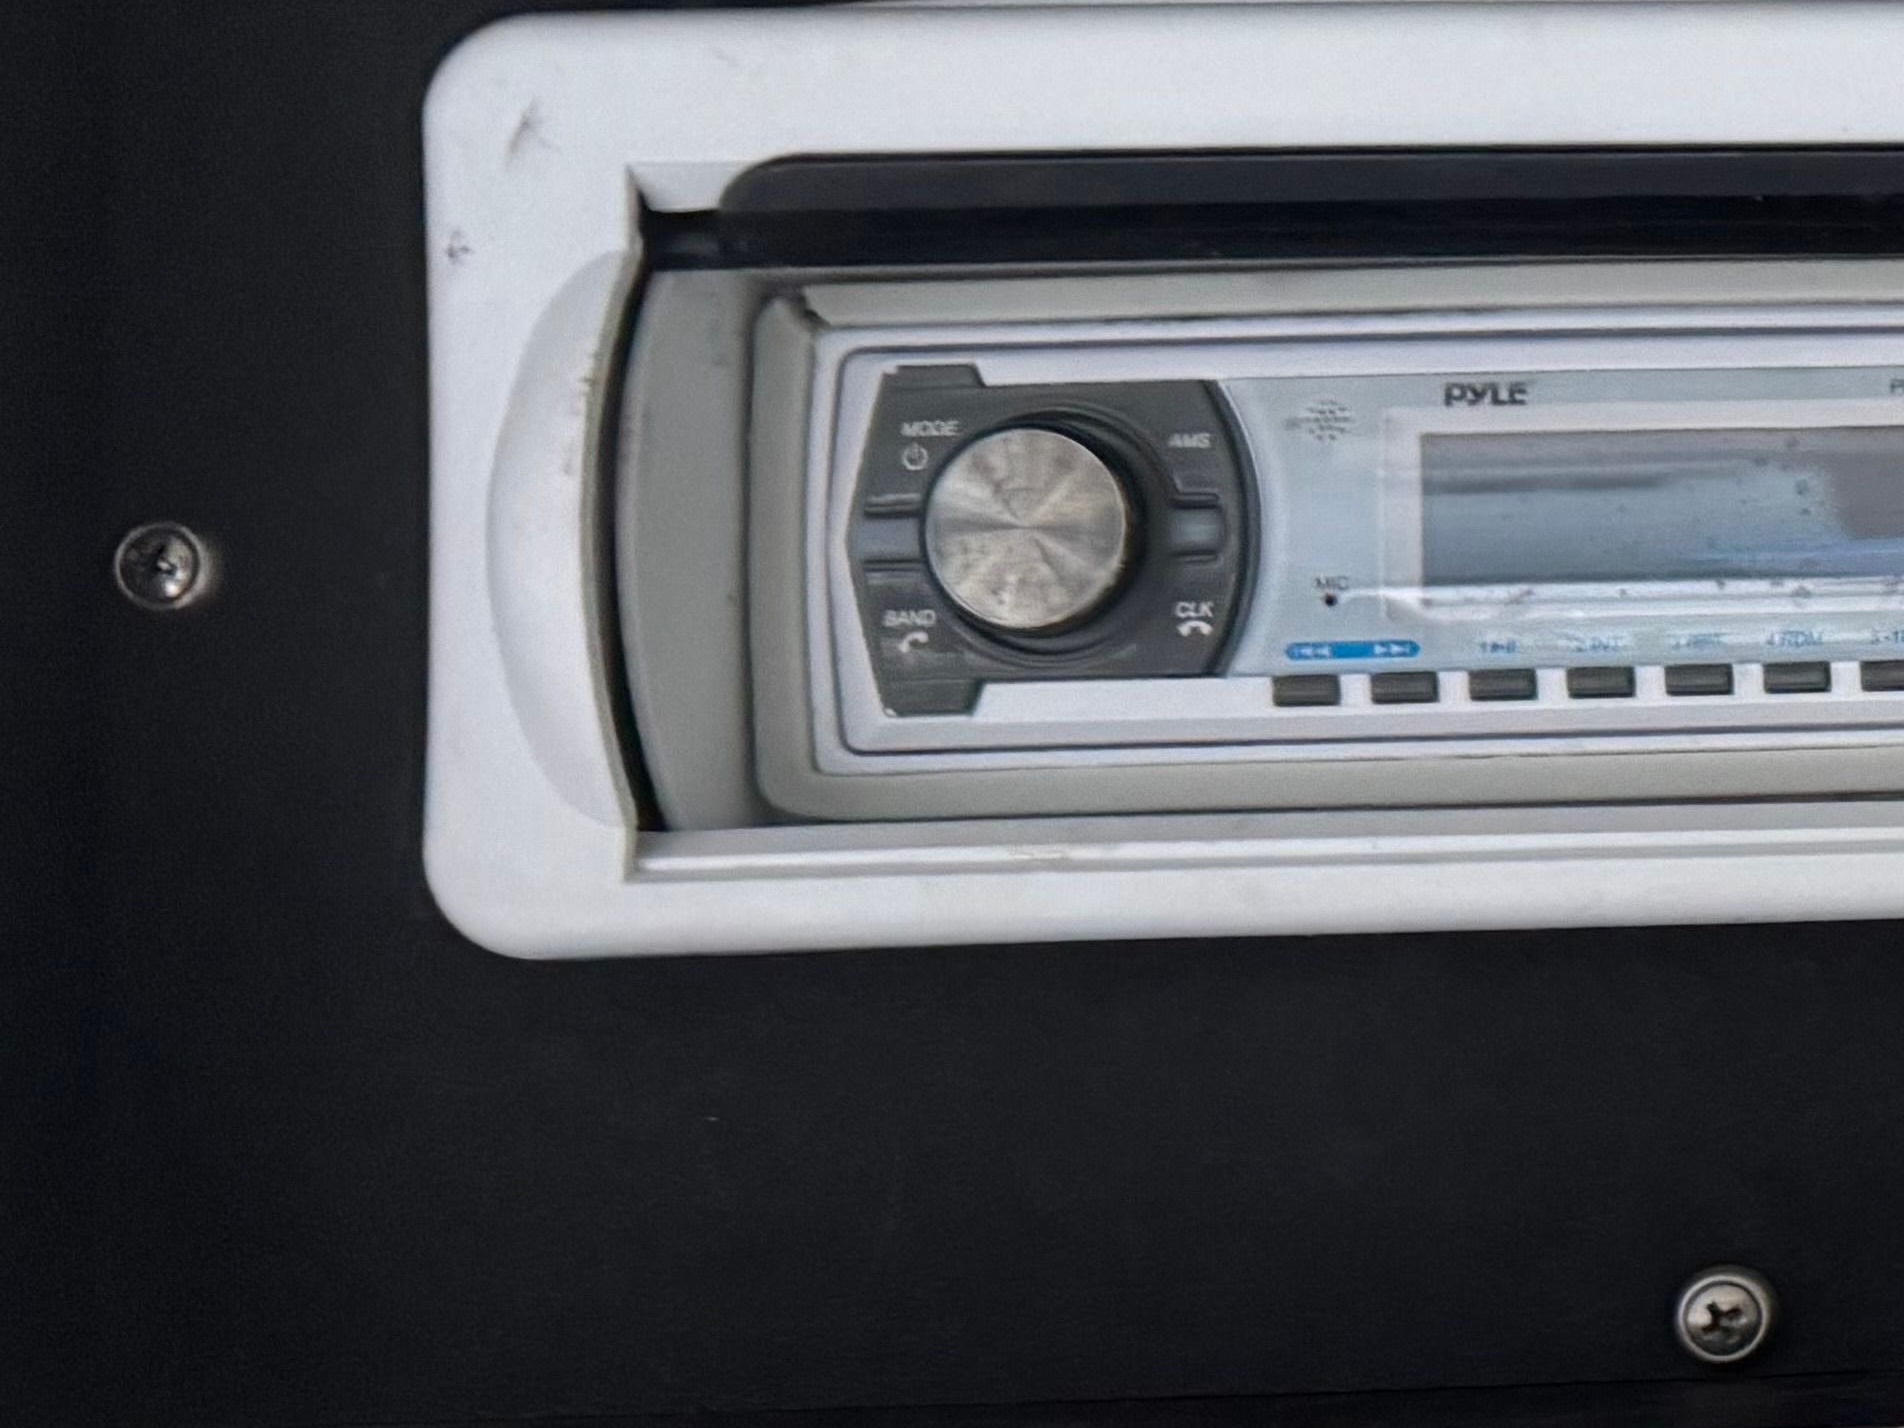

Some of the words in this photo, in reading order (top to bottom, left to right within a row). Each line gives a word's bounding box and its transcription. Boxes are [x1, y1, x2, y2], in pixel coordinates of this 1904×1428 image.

[1444, 380, 1529, 408] PYLE
[901, 419, 960, 438] MODE
[1168, 432, 1211, 449] AMS
[883, 608, 937, 627] BAND
[1174, 600, 1215, 618] CLK
